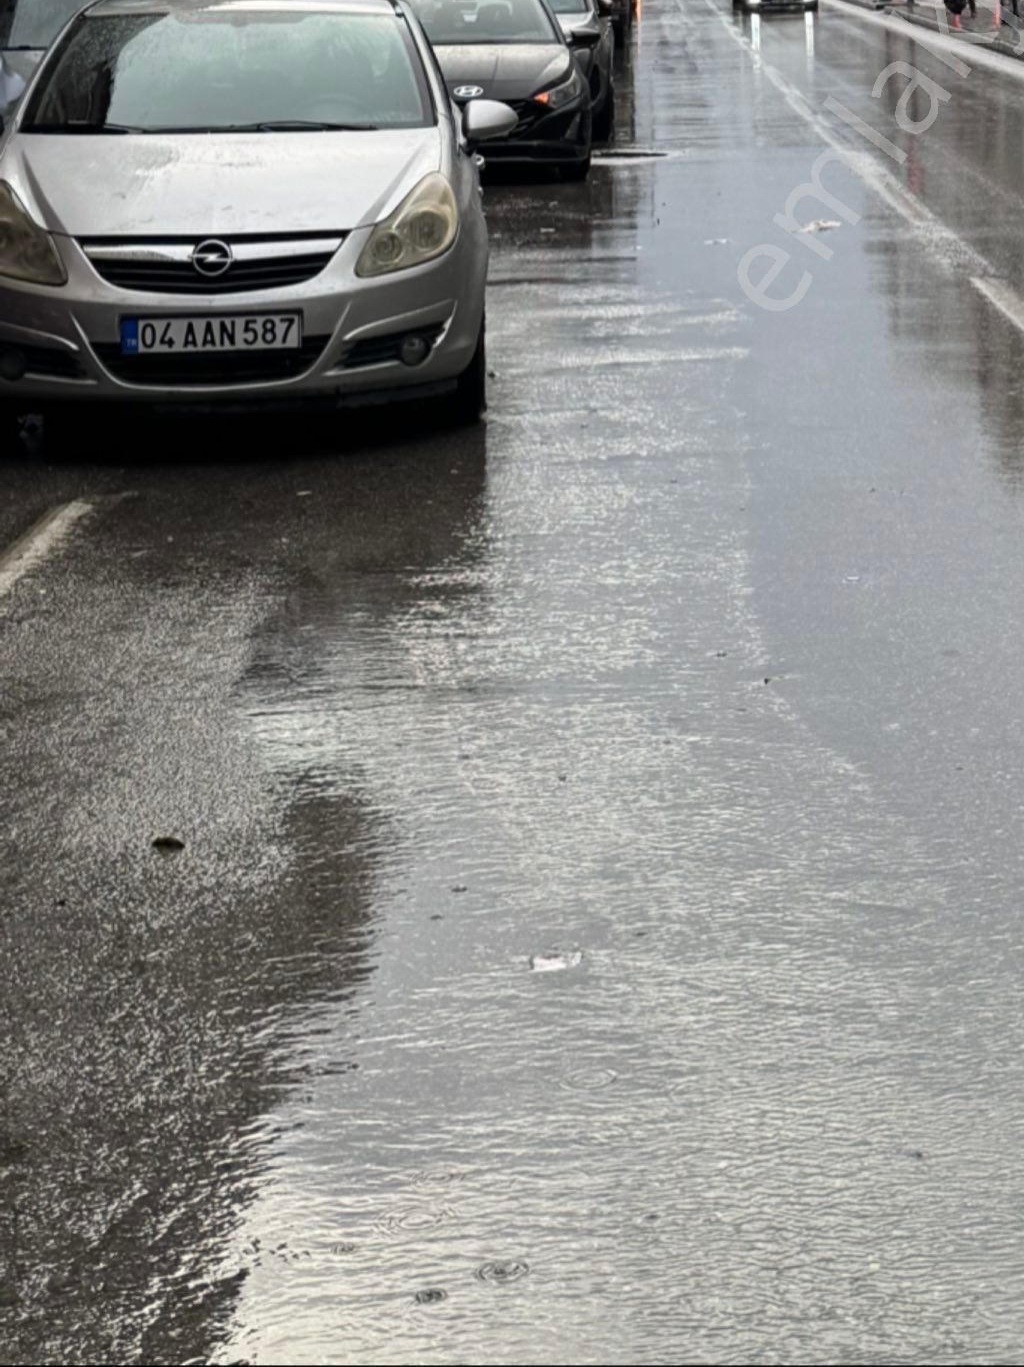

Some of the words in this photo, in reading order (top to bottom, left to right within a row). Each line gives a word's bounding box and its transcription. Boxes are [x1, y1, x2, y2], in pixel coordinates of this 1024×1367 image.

[141, 322, 175, 348] 04
[182, 320, 236, 348] AAN
[243, 317, 296, 345] 587
